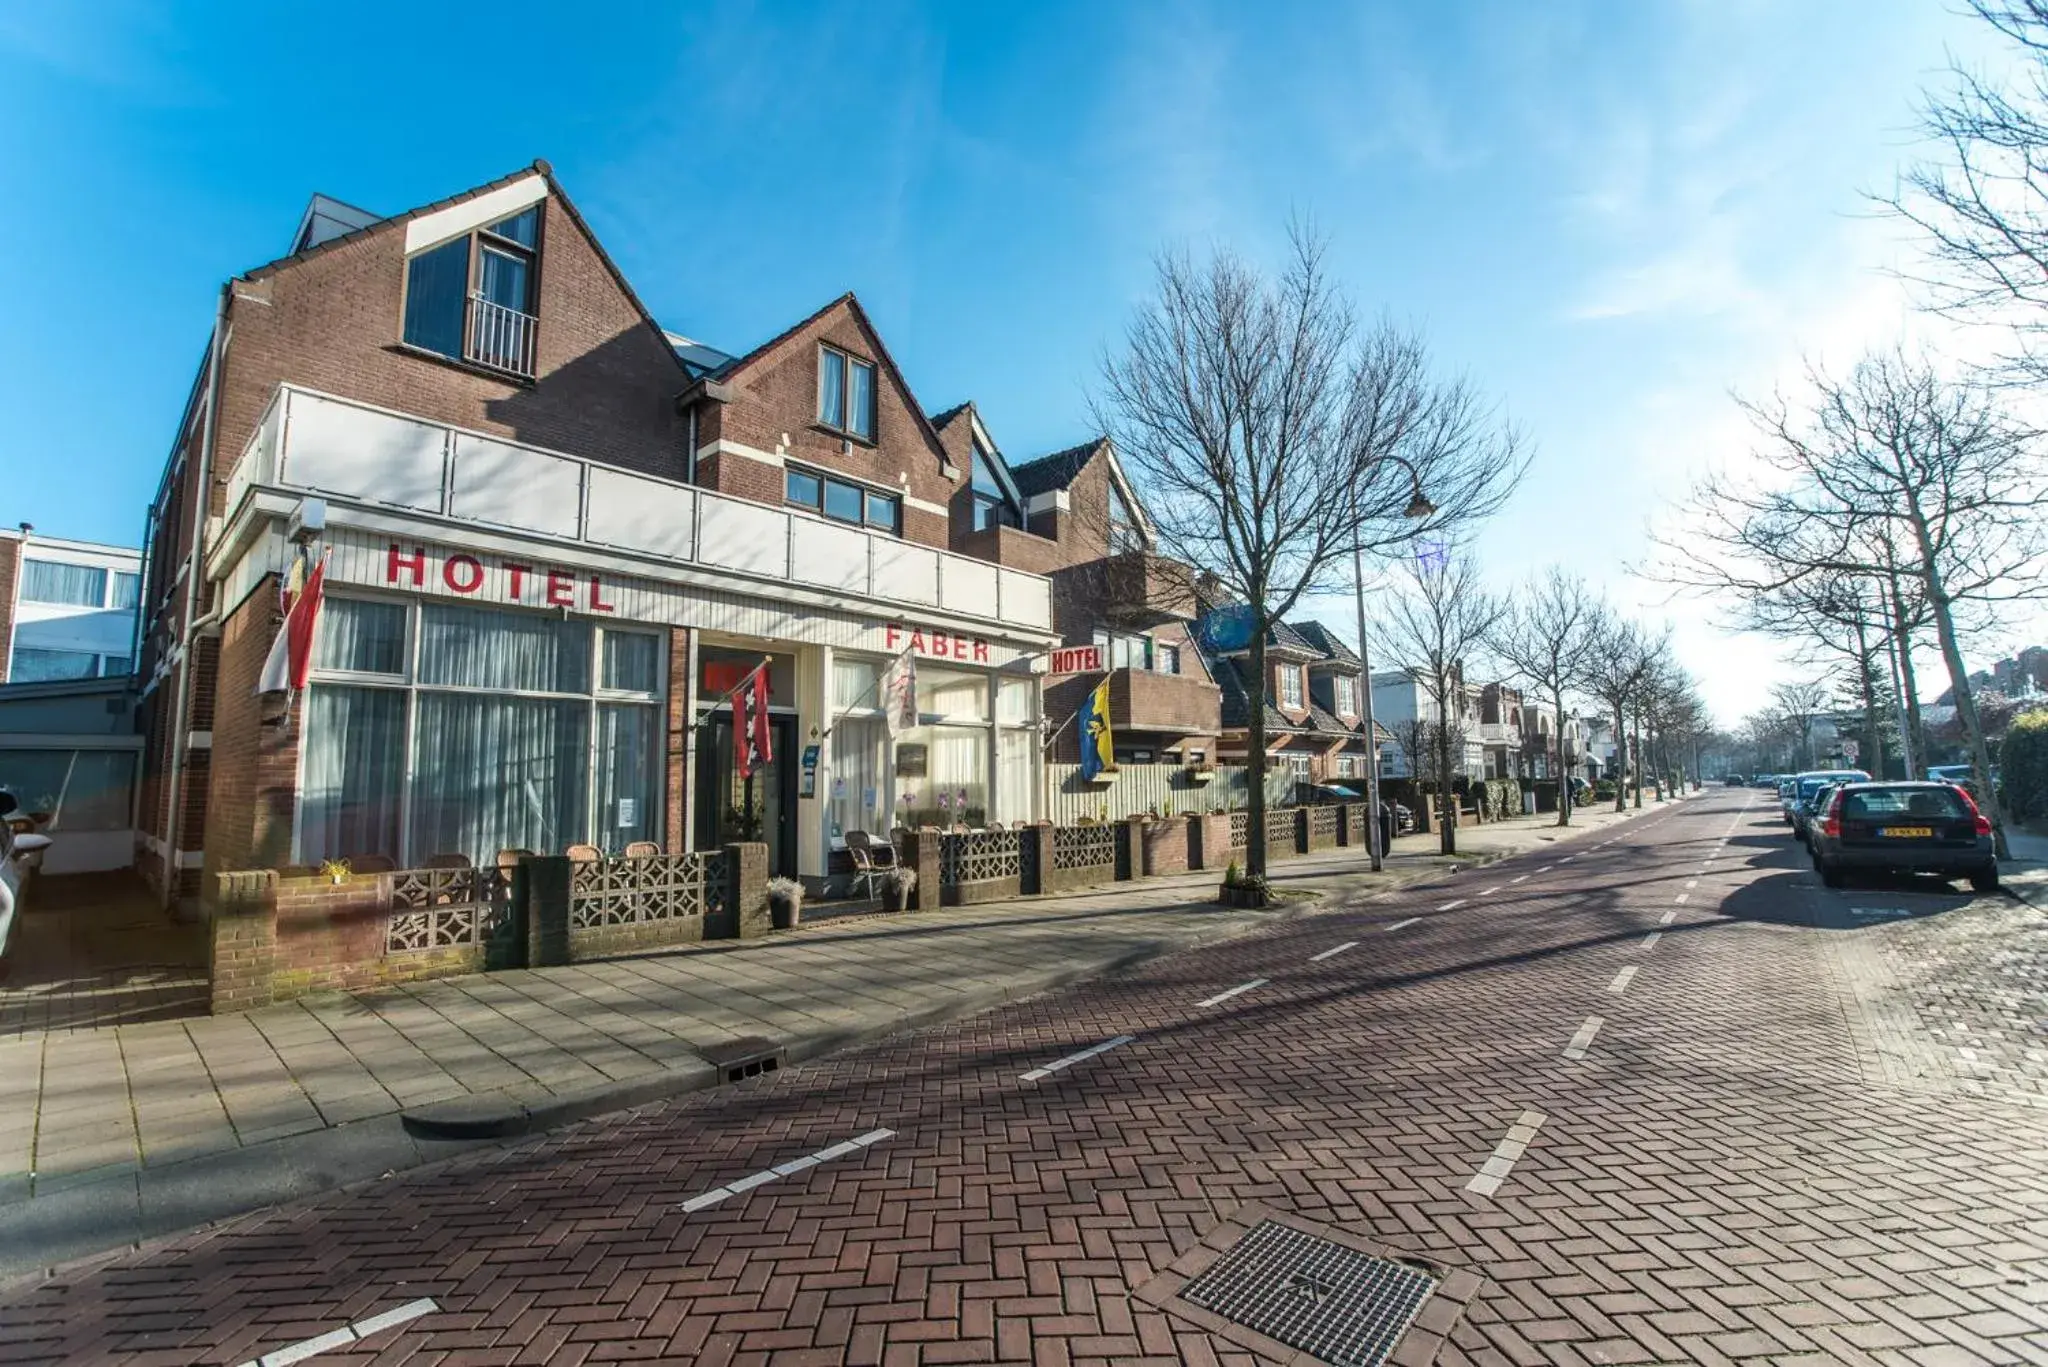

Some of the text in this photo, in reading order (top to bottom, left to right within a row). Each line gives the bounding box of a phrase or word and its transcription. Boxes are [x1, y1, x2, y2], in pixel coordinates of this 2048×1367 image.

[387, 544, 613, 612] HOTEL
[886, 623, 988, 662] FABER
[1052, 648, 1101, 673] HOTEL
